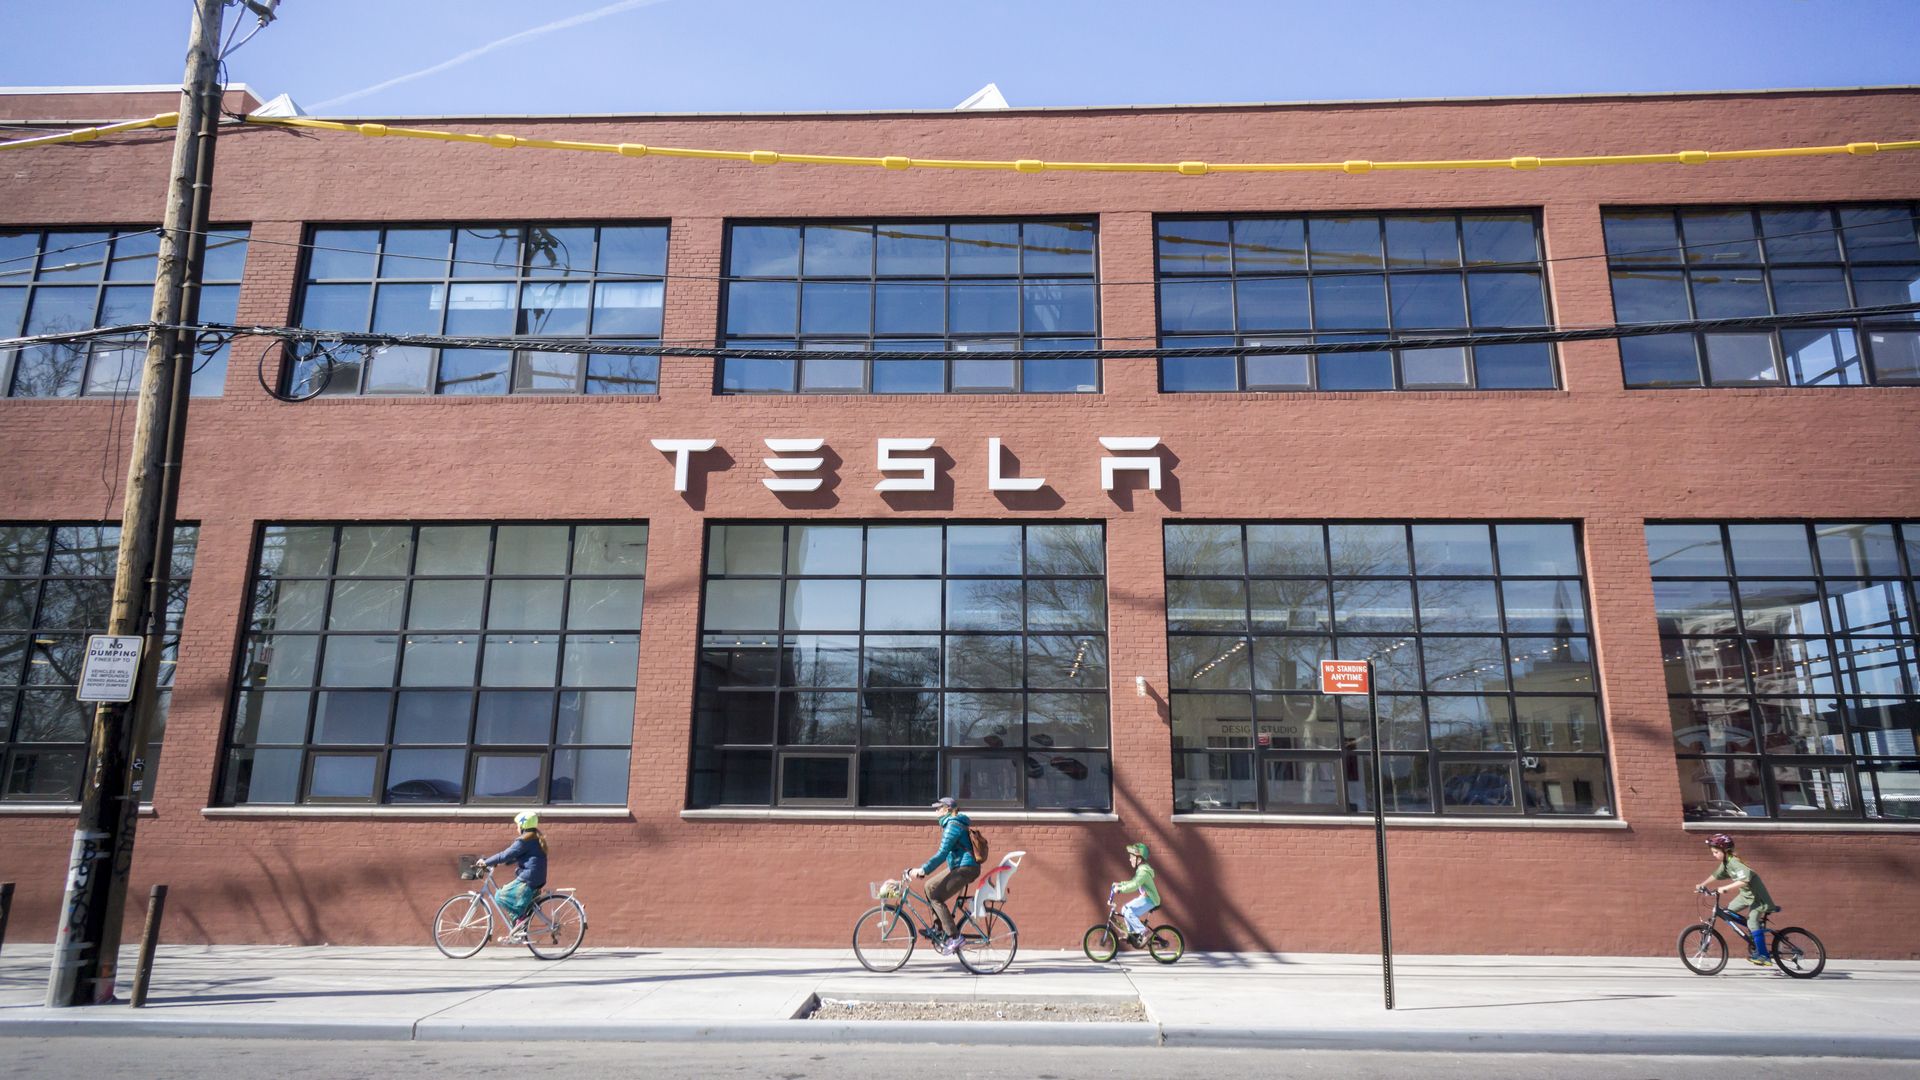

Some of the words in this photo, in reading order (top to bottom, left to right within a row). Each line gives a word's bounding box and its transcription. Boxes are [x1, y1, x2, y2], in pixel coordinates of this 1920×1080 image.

[650, 436, 1162, 492] TESLA
[1221, 725, 1251, 734] DESIG
[1260, 725, 1298, 734] STUDIO
